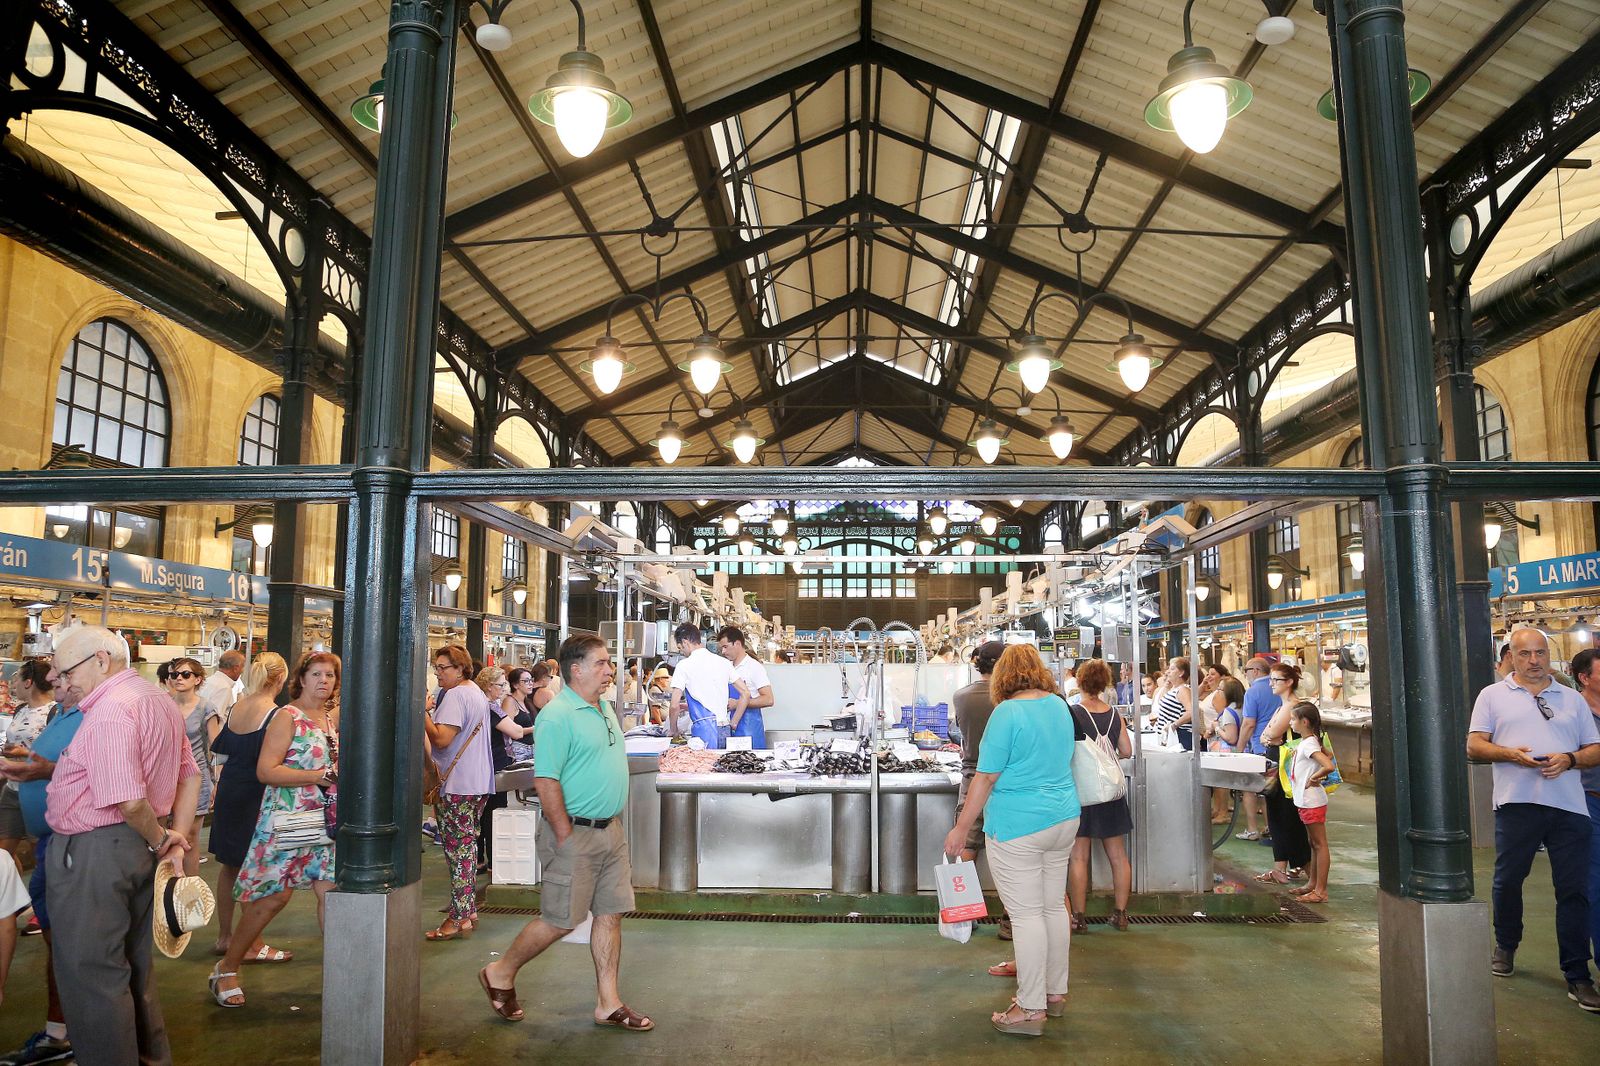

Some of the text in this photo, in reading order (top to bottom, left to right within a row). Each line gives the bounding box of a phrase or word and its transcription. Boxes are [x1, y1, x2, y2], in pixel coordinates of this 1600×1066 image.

[72, 547, 102, 582] 15
[141, 562, 205, 593] M.Segura
[1538, 564, 1560, 586] LA
[227, 572, 249, 601] 16
[1507, 566, 1519, 594] 5
[952, 875, 967, 893] g
